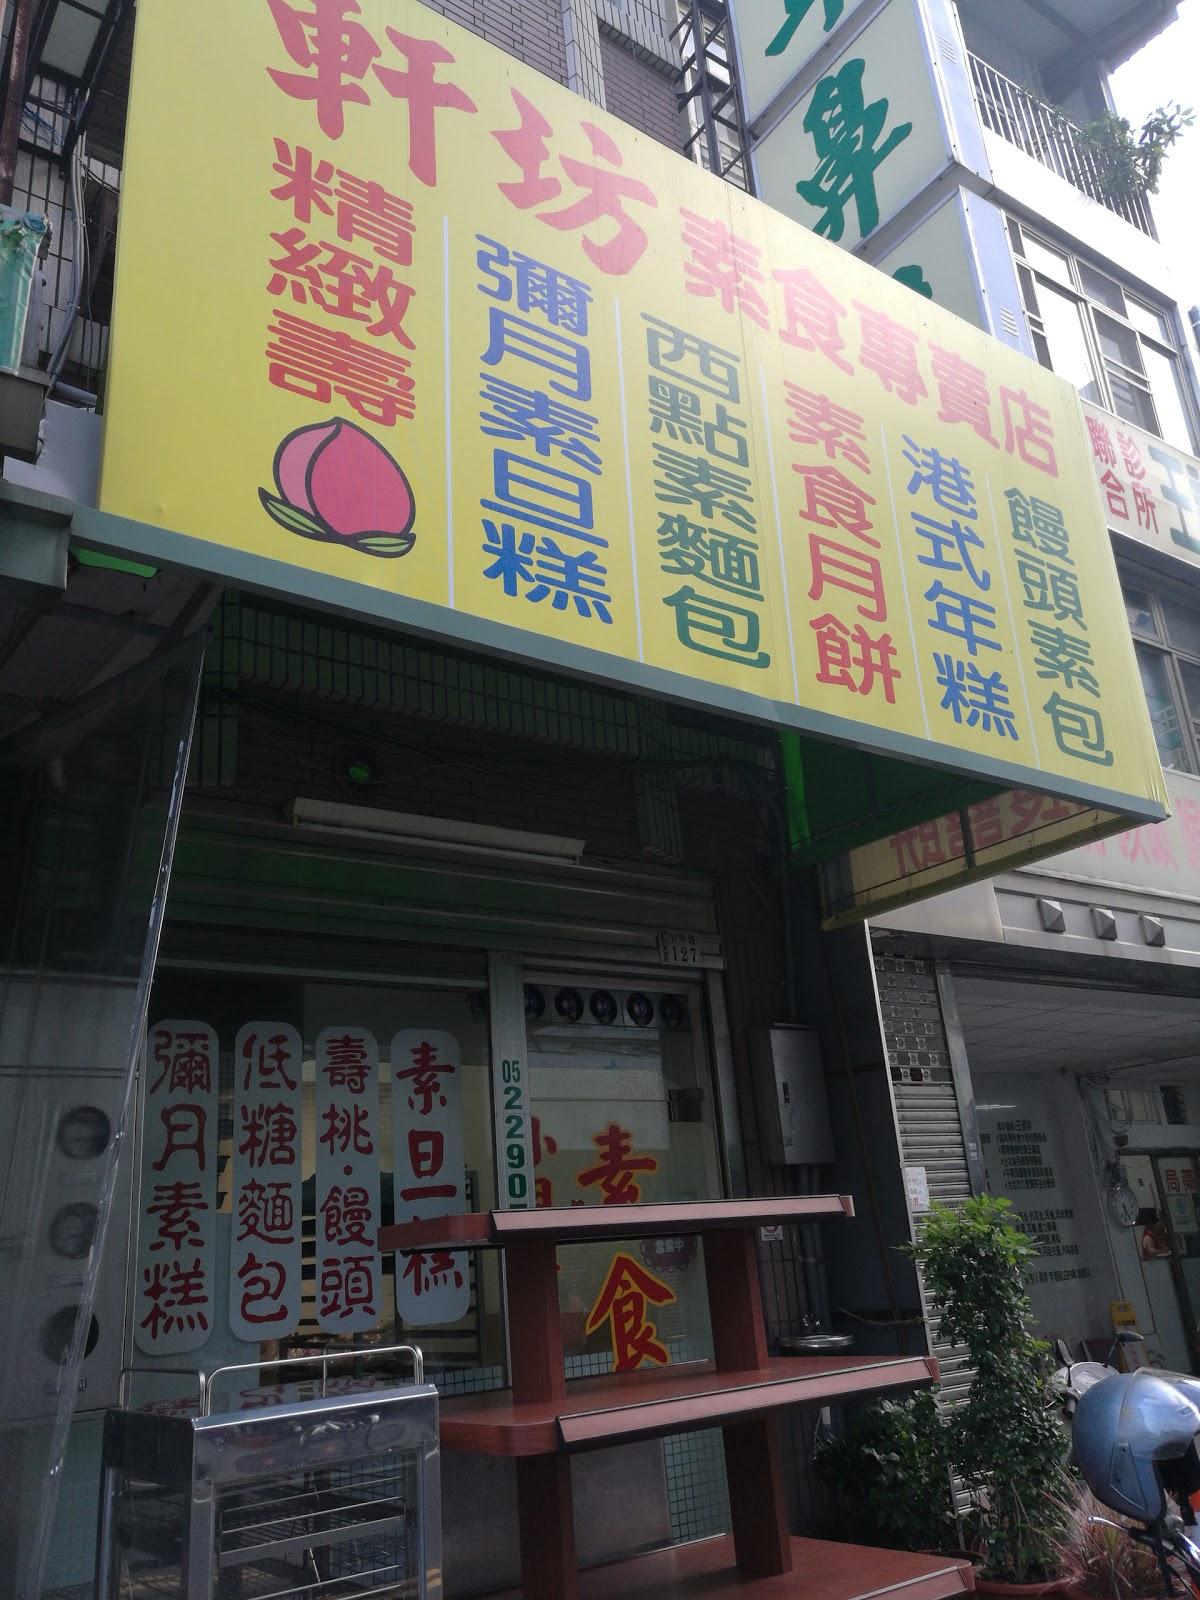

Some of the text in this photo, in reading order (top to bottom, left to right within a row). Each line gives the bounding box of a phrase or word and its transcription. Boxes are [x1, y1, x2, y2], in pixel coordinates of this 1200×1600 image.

[265, 138, 416, 427] 精緻壽
[679, 206, 1058, 477] 素食專賣店
[640, 312, 770, 669] 西點素麵包
[783, 379, 901, 704] 素食月餅
[901, 433, 1020, 740] 港式年糕
[1003, 486, 1113, 766] 饅頭素包
[672, 946, 697, 963] 127
[139, 1030, 213, 1341] 彌月素糕
[237, 1033, 298, 1324] 低糖麵包
